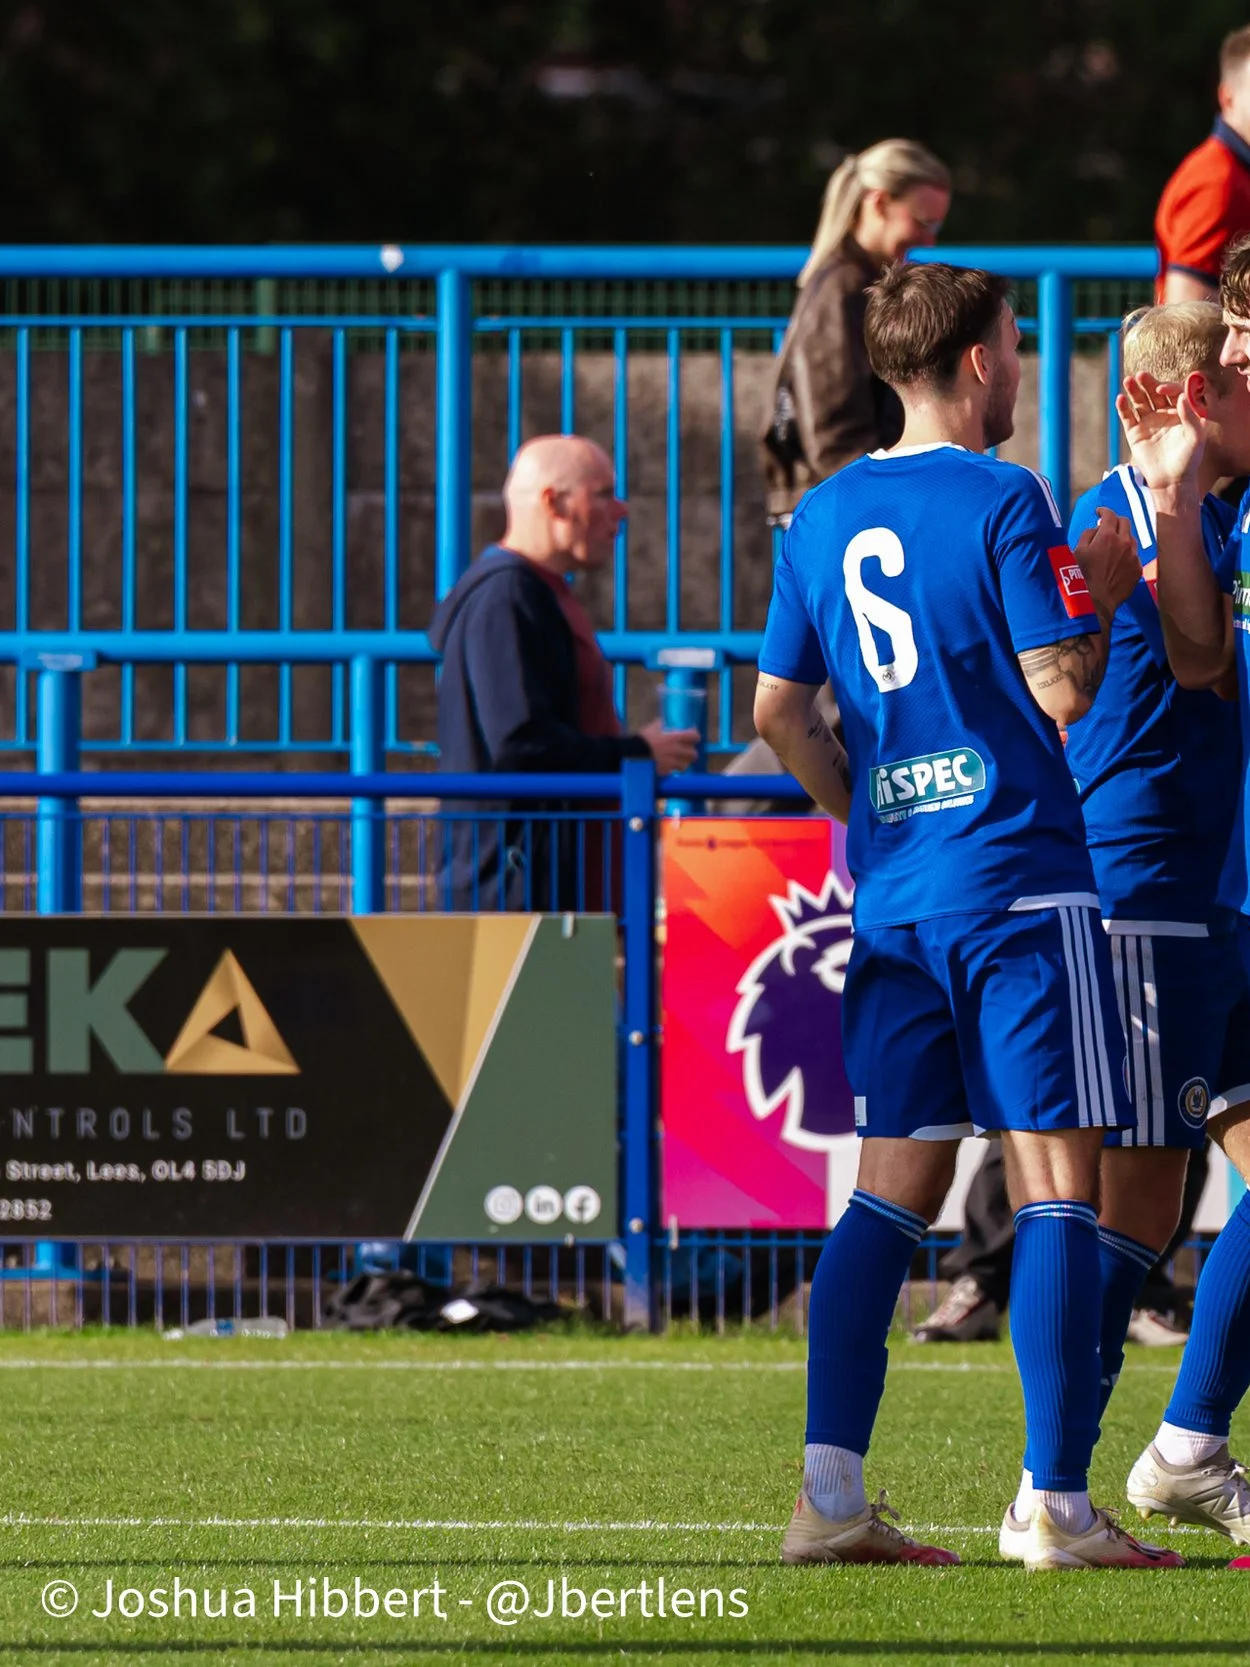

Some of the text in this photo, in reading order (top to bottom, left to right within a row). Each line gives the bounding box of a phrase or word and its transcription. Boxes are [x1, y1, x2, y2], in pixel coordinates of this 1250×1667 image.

[843, 527, 918, 693] 6
[12, 1107, 307, 1140] NTROLS LTD
[5, 1159, 82, 1184] Street,
[86, 1159, 147, 1184] Lees,
[152, 1159, 196, 1182] OL4
